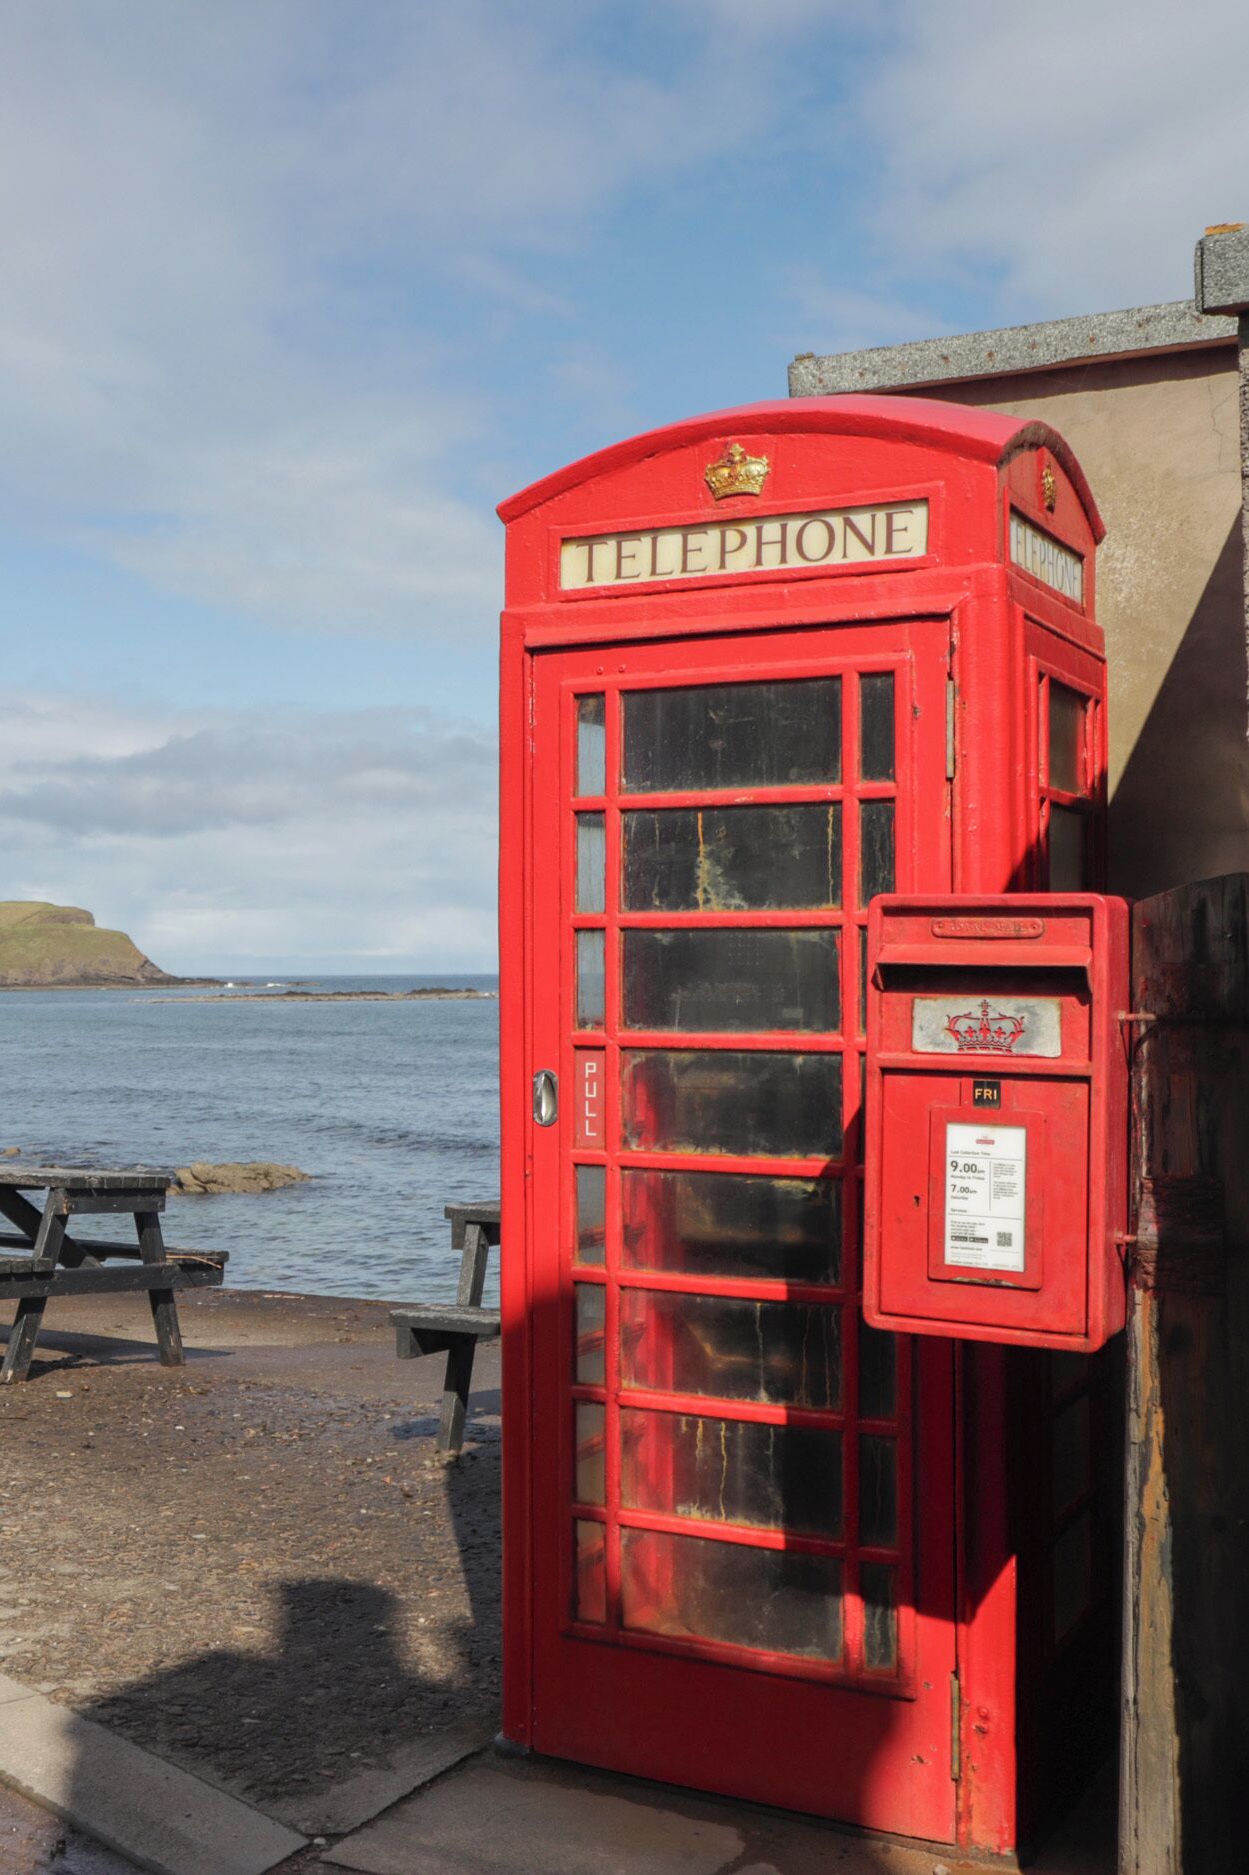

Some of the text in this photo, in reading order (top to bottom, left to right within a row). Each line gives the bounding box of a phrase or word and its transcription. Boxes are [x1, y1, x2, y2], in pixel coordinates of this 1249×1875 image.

[576, 508, 916, 583] TELEPHONE
[1015, 518, 1081, 602] ELEPHONE
[585, 1062, 597, 1136] PULL
[975, 1088, 997, 1100] FRI
